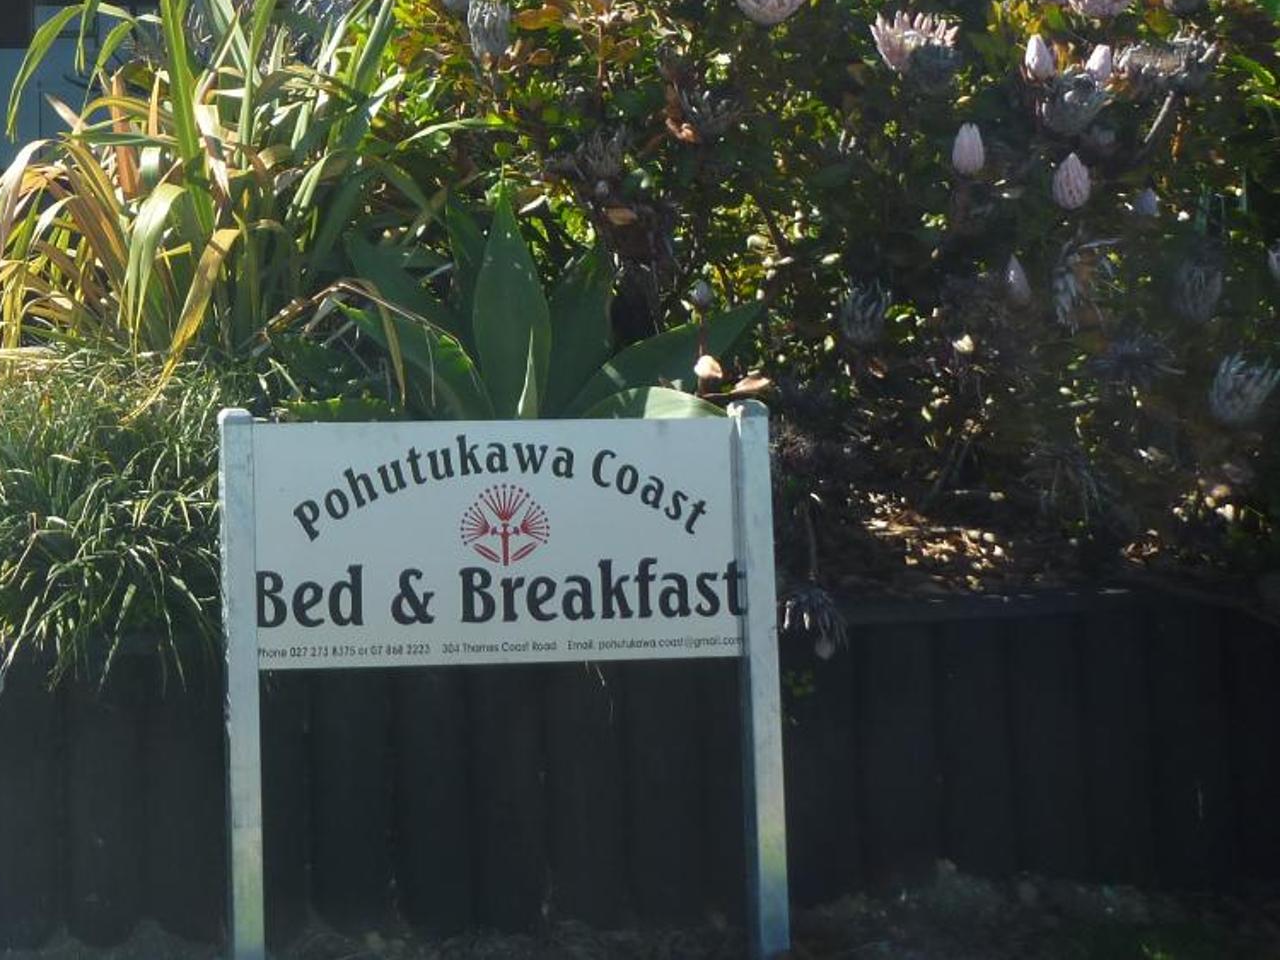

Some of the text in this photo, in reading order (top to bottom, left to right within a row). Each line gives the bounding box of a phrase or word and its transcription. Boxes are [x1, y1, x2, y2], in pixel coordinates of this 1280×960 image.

[293, 434, 707, 542] Pohutukawa Coast
[256, 557, 747, 628] Bed & Breakfast
[290, 646, 308, 658] 027
[501, 641, 530, 652] Coast
